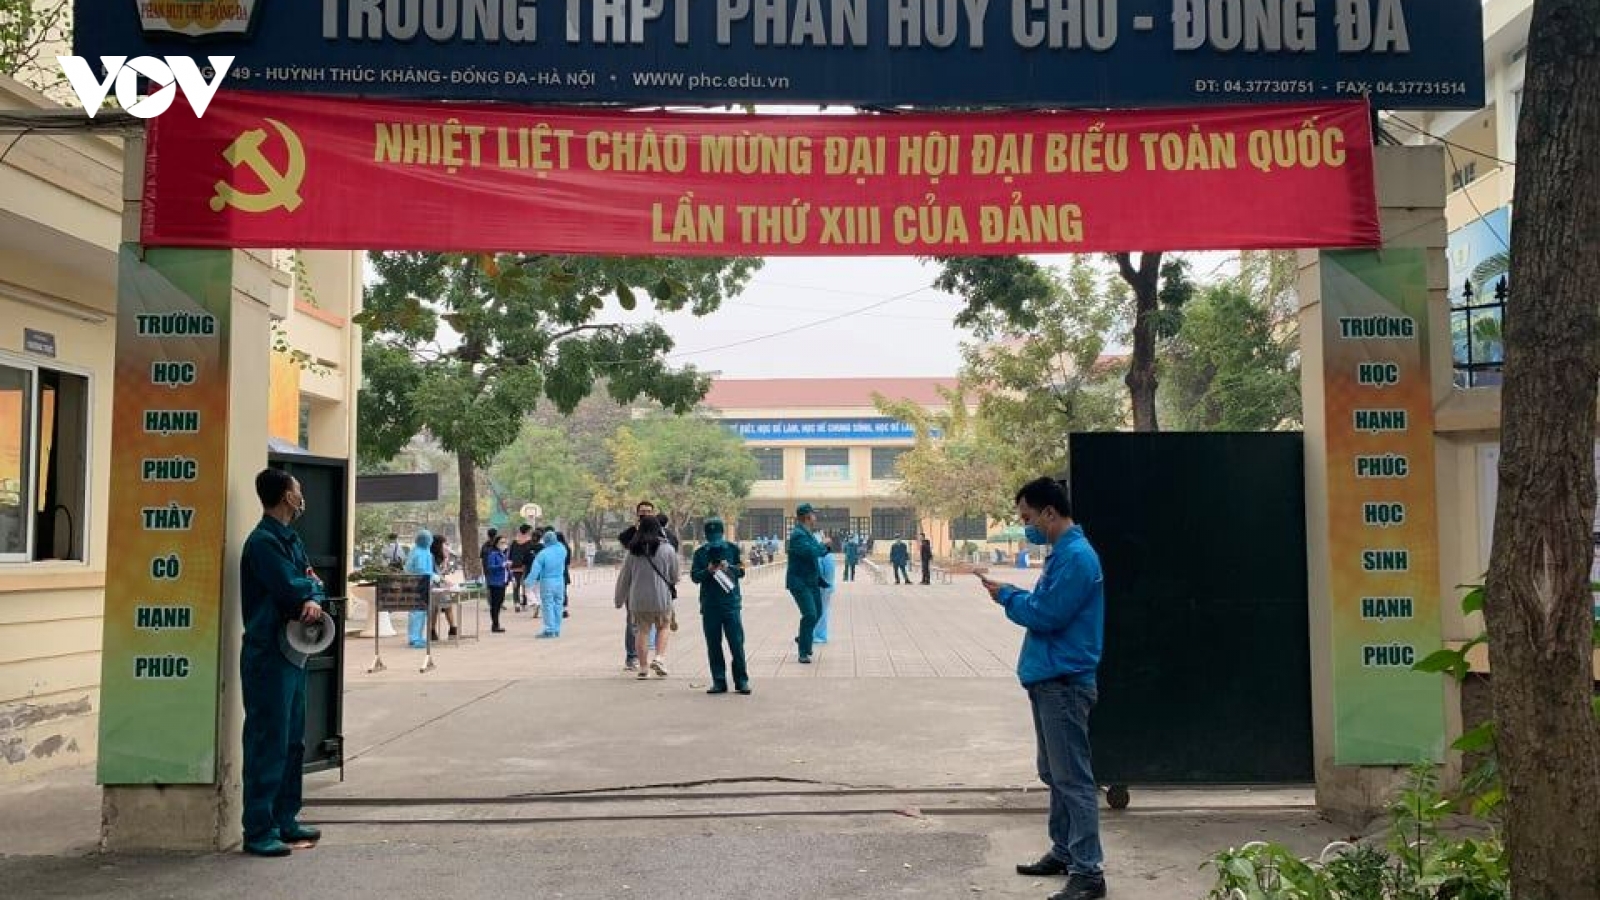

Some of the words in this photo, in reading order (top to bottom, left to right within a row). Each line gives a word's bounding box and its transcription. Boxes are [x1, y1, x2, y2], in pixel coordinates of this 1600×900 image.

[266, 64, 324, 80] HUỲNH
[330, 65, 376, 82] THÚC
[567, 69, 595, 88] NỘI
[633, 72, 684, 86] WWW
[688, 72, 789, 90] phc.edu.vn
[1224, 80, 1314, 93] 04.37730751
[1376, 81, 1466, 95] 04.37731514
[374, 118, 485, 173] NHIỆT
[498, 123, 573, 178] LIỆT
[586, 126, 687, 172] CHÀO
[700, 130, 812, 174] MỪNG
[824, 135, 886, 184] ĐẠI
[898, 131, 959, 184] HỘI
[971, 133, 1034, 183] ĐẠI
[1139, 125, 1237, 171] TOÀN
[1248, 115, 1346, 172] QUỐC
[652, 191, 724, 243] LẦN
[737, 198, 811, 244] THỨ
[820, 206, 881, 244] XIII
[894, 193, 969, 244] CỦA
[980, 191, 1083, 243] ĐẢNG
[136, 314, 215, 335] TRƯỜNG
[1340, 315, 1414, 338] TRƯỜNG
[153, 362, 195, 384] HỌC
[1359, 364, 1398, 386] HỌC
[145, 411, 199, 434] HẠNH
[1355, 411, 1406, 433] HẠNH
[143, 457, 196, 480] PHÚC
[1357, 454, 1408, 477] PHÚC
[1364, 504, 1403, 526] HỌC
[152, 555, 180, 578] CÔ
[1362, 550, 1408, 571] SINH
[136, 607, 191, 630] HẠNH
[1362, 597, 1413, 620] HẠNH
[1363, 643, 1414, 666] PHÚC
[135, 656, 190, 678] PHÚC
